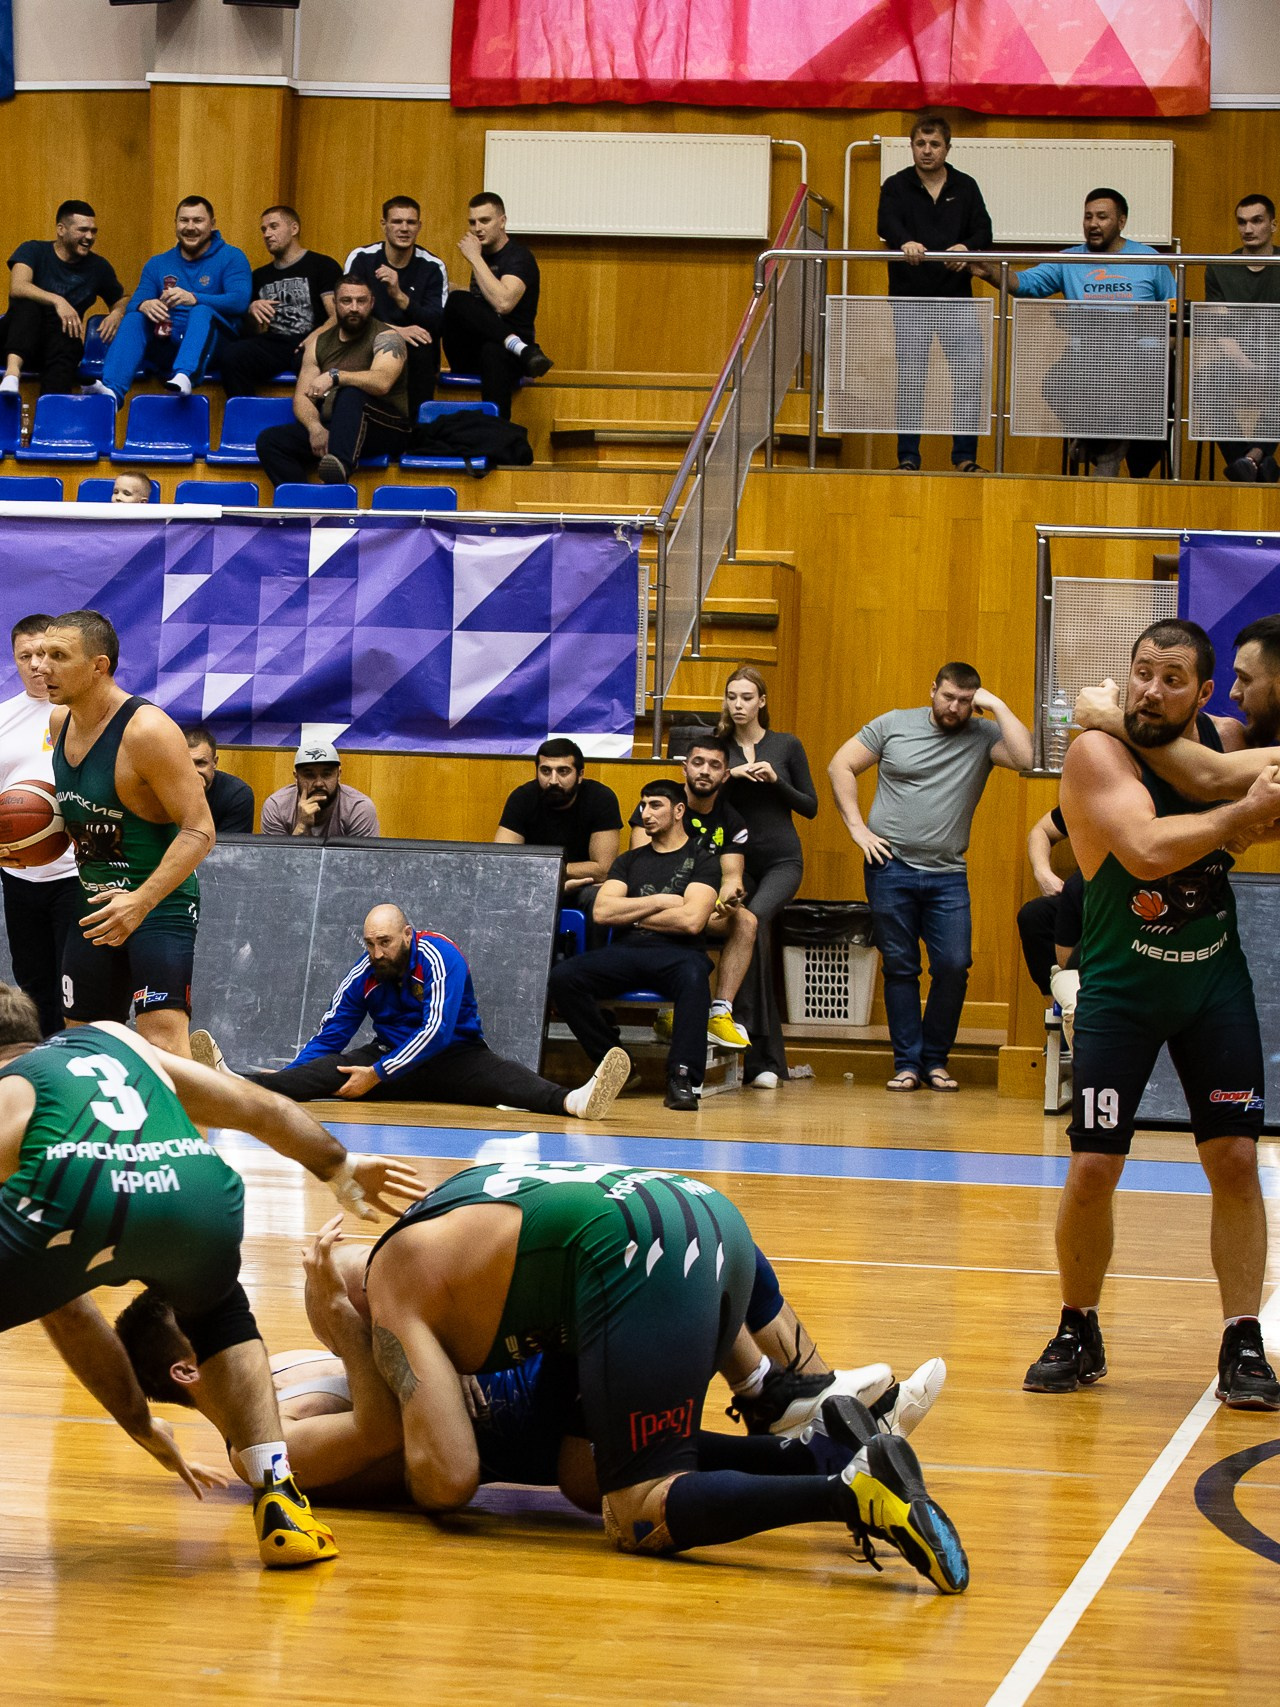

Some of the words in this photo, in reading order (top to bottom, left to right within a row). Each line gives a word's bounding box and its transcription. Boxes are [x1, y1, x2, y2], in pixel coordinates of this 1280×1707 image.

[1083, 283, 1133, 293] CYPRESS
[1131, 931, 1228, 963] МЕДВЕДИ
[65, 1053, 149, 1131] 3
[1082, 1087, 1119, 1129] 19
[110, 1164, 180, 1193] КРАЙ
